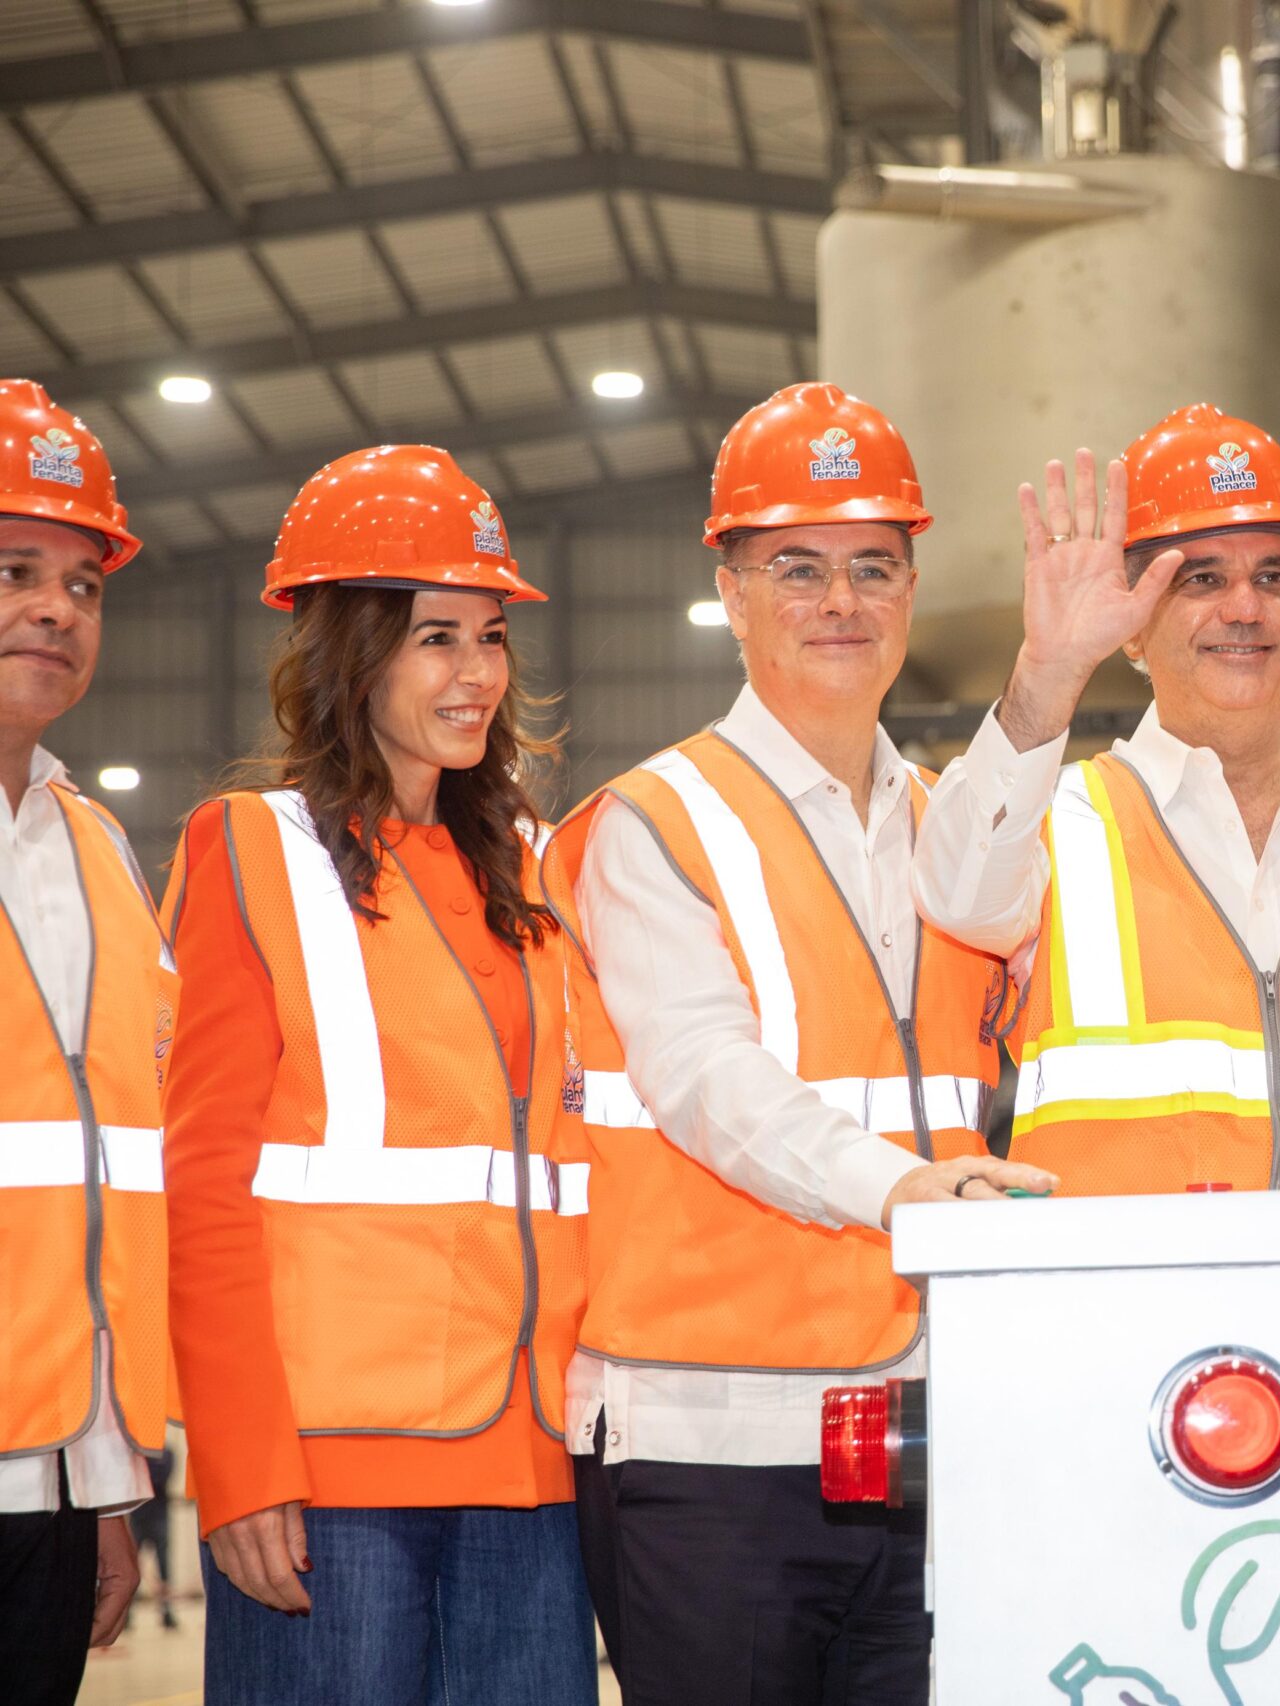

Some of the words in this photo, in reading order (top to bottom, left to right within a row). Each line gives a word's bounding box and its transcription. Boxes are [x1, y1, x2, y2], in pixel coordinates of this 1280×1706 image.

[33, 457, 82, 477] planta
[812, 459, 859, 471] planta
[33, 468, 82, 486] renacer
[812, 469, 859, 479] renacer
[1211, 470, 1256, 486] planta
